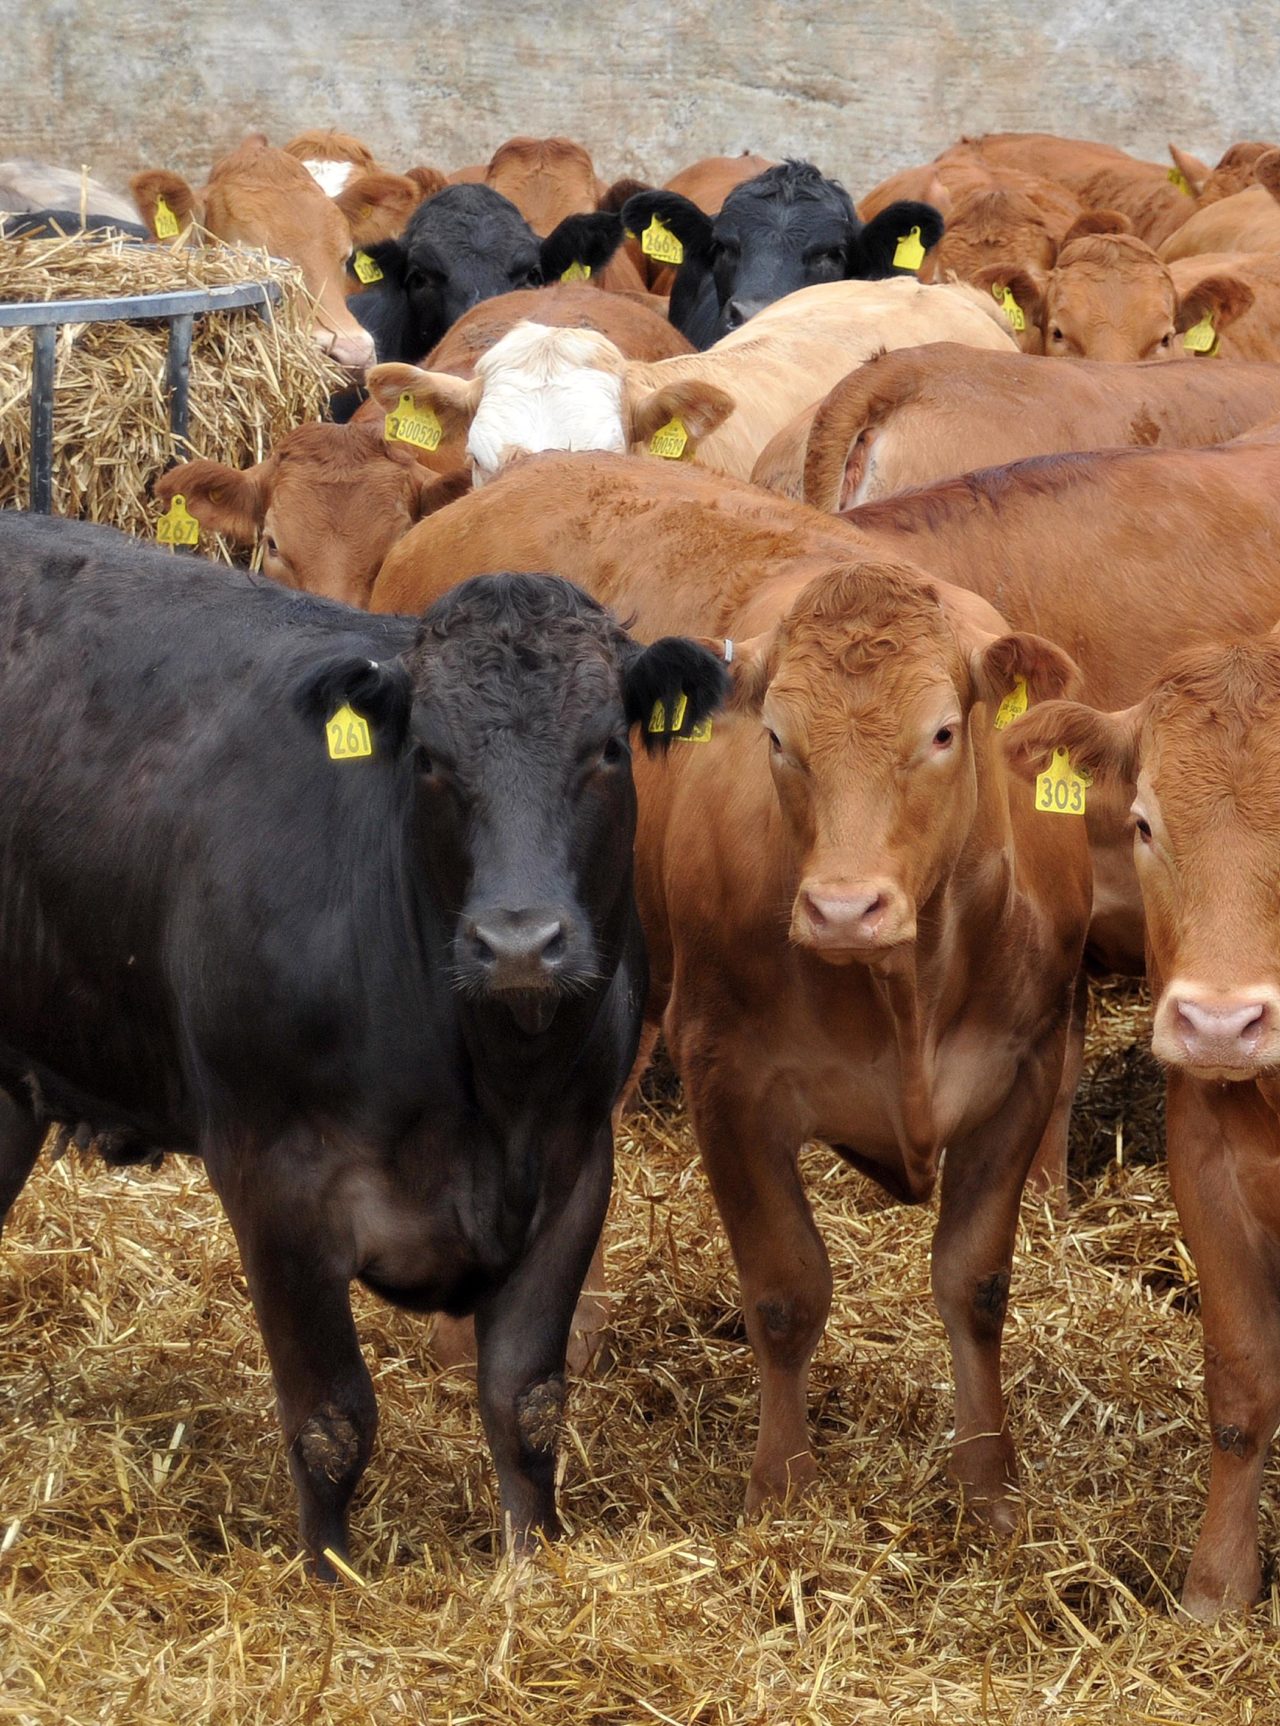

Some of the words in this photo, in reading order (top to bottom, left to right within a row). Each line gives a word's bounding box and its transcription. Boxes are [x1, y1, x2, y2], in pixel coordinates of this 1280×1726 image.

[646, 232, 670, 254] 266
[398, 417, 441, 448] 300529
[161, 519, 197, 541] 267
[331, 721, 369, 755] 261
[1041, 777, 1082, 811] 303
